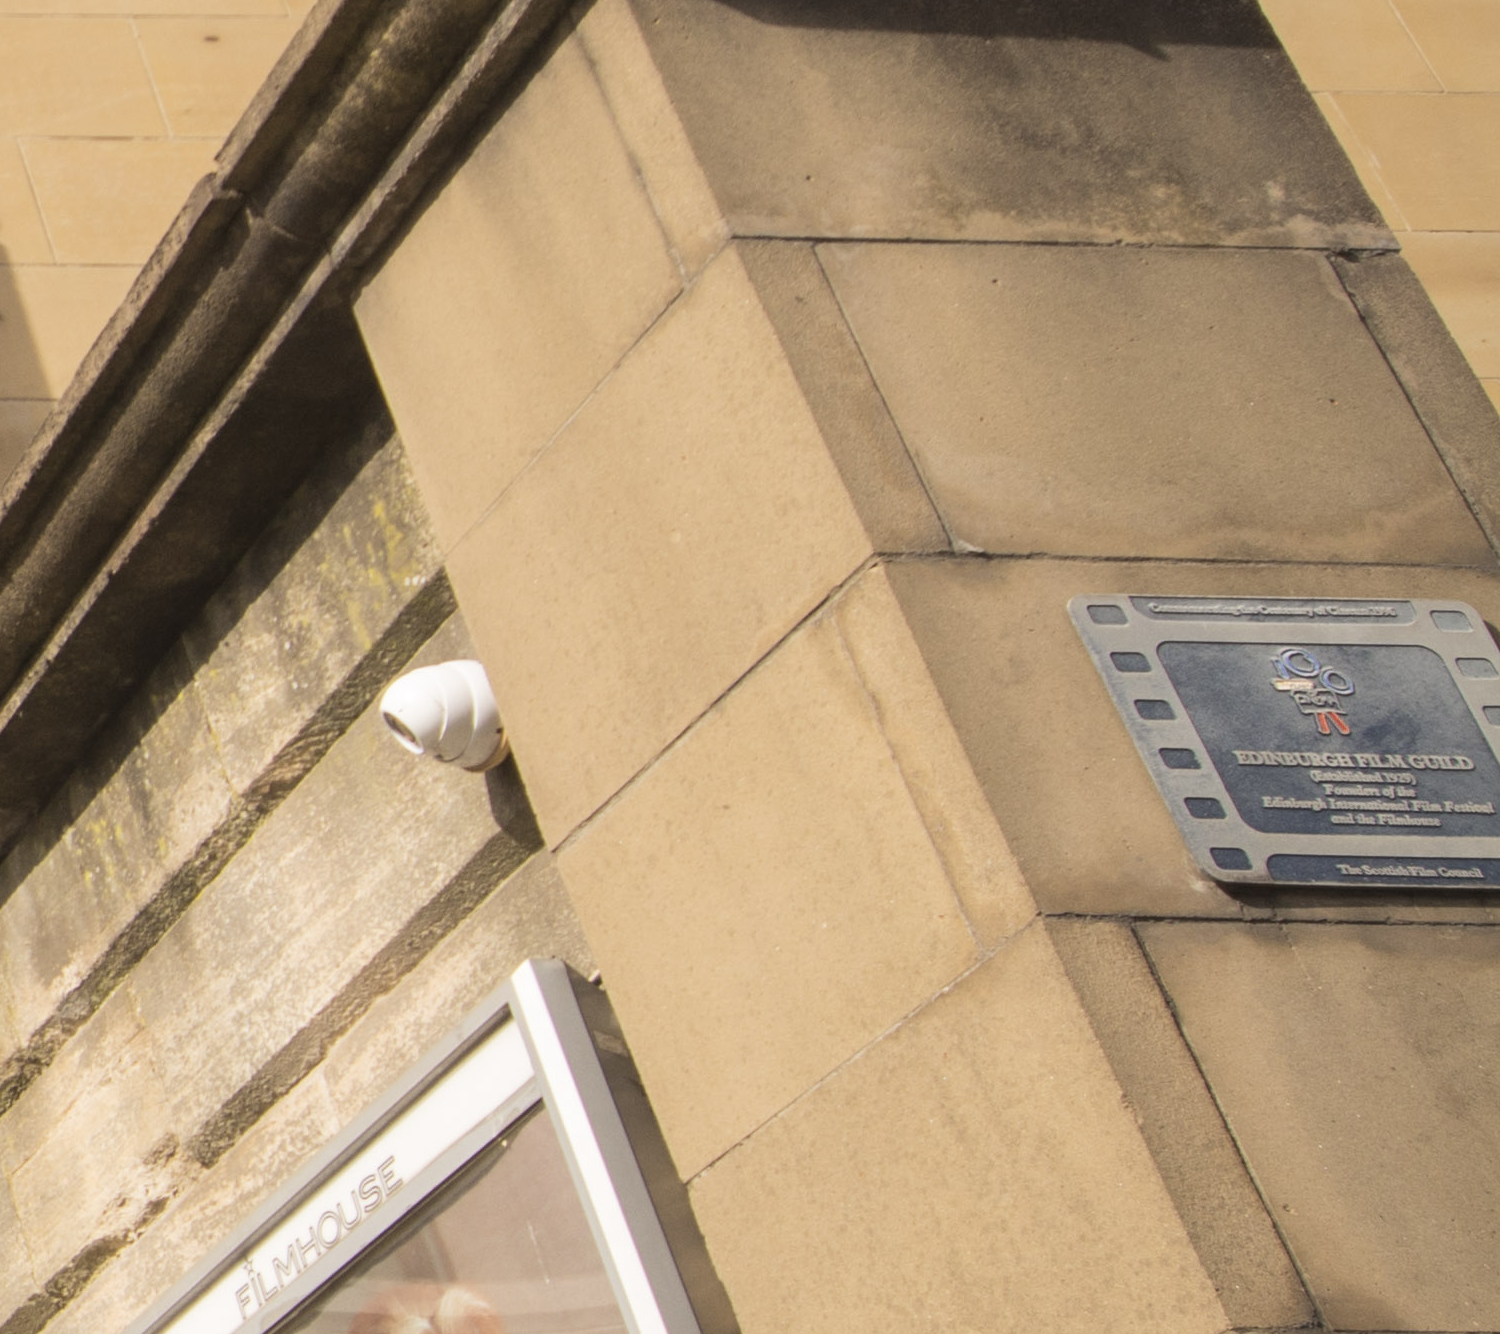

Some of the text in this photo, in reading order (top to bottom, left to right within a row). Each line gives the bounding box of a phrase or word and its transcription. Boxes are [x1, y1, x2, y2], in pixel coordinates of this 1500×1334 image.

[1232, 750, 1476, 771] EDINBURGH FILM GUILD
[1261, 796, 1497, 815] Edinburgh International Film Festival
[1377, 815, 1443, 827] Filmhouse
[1336, 864, 1485, 879] The Scottish Film Council
[235, 1154, 404, 1320] FILMHOUSE
